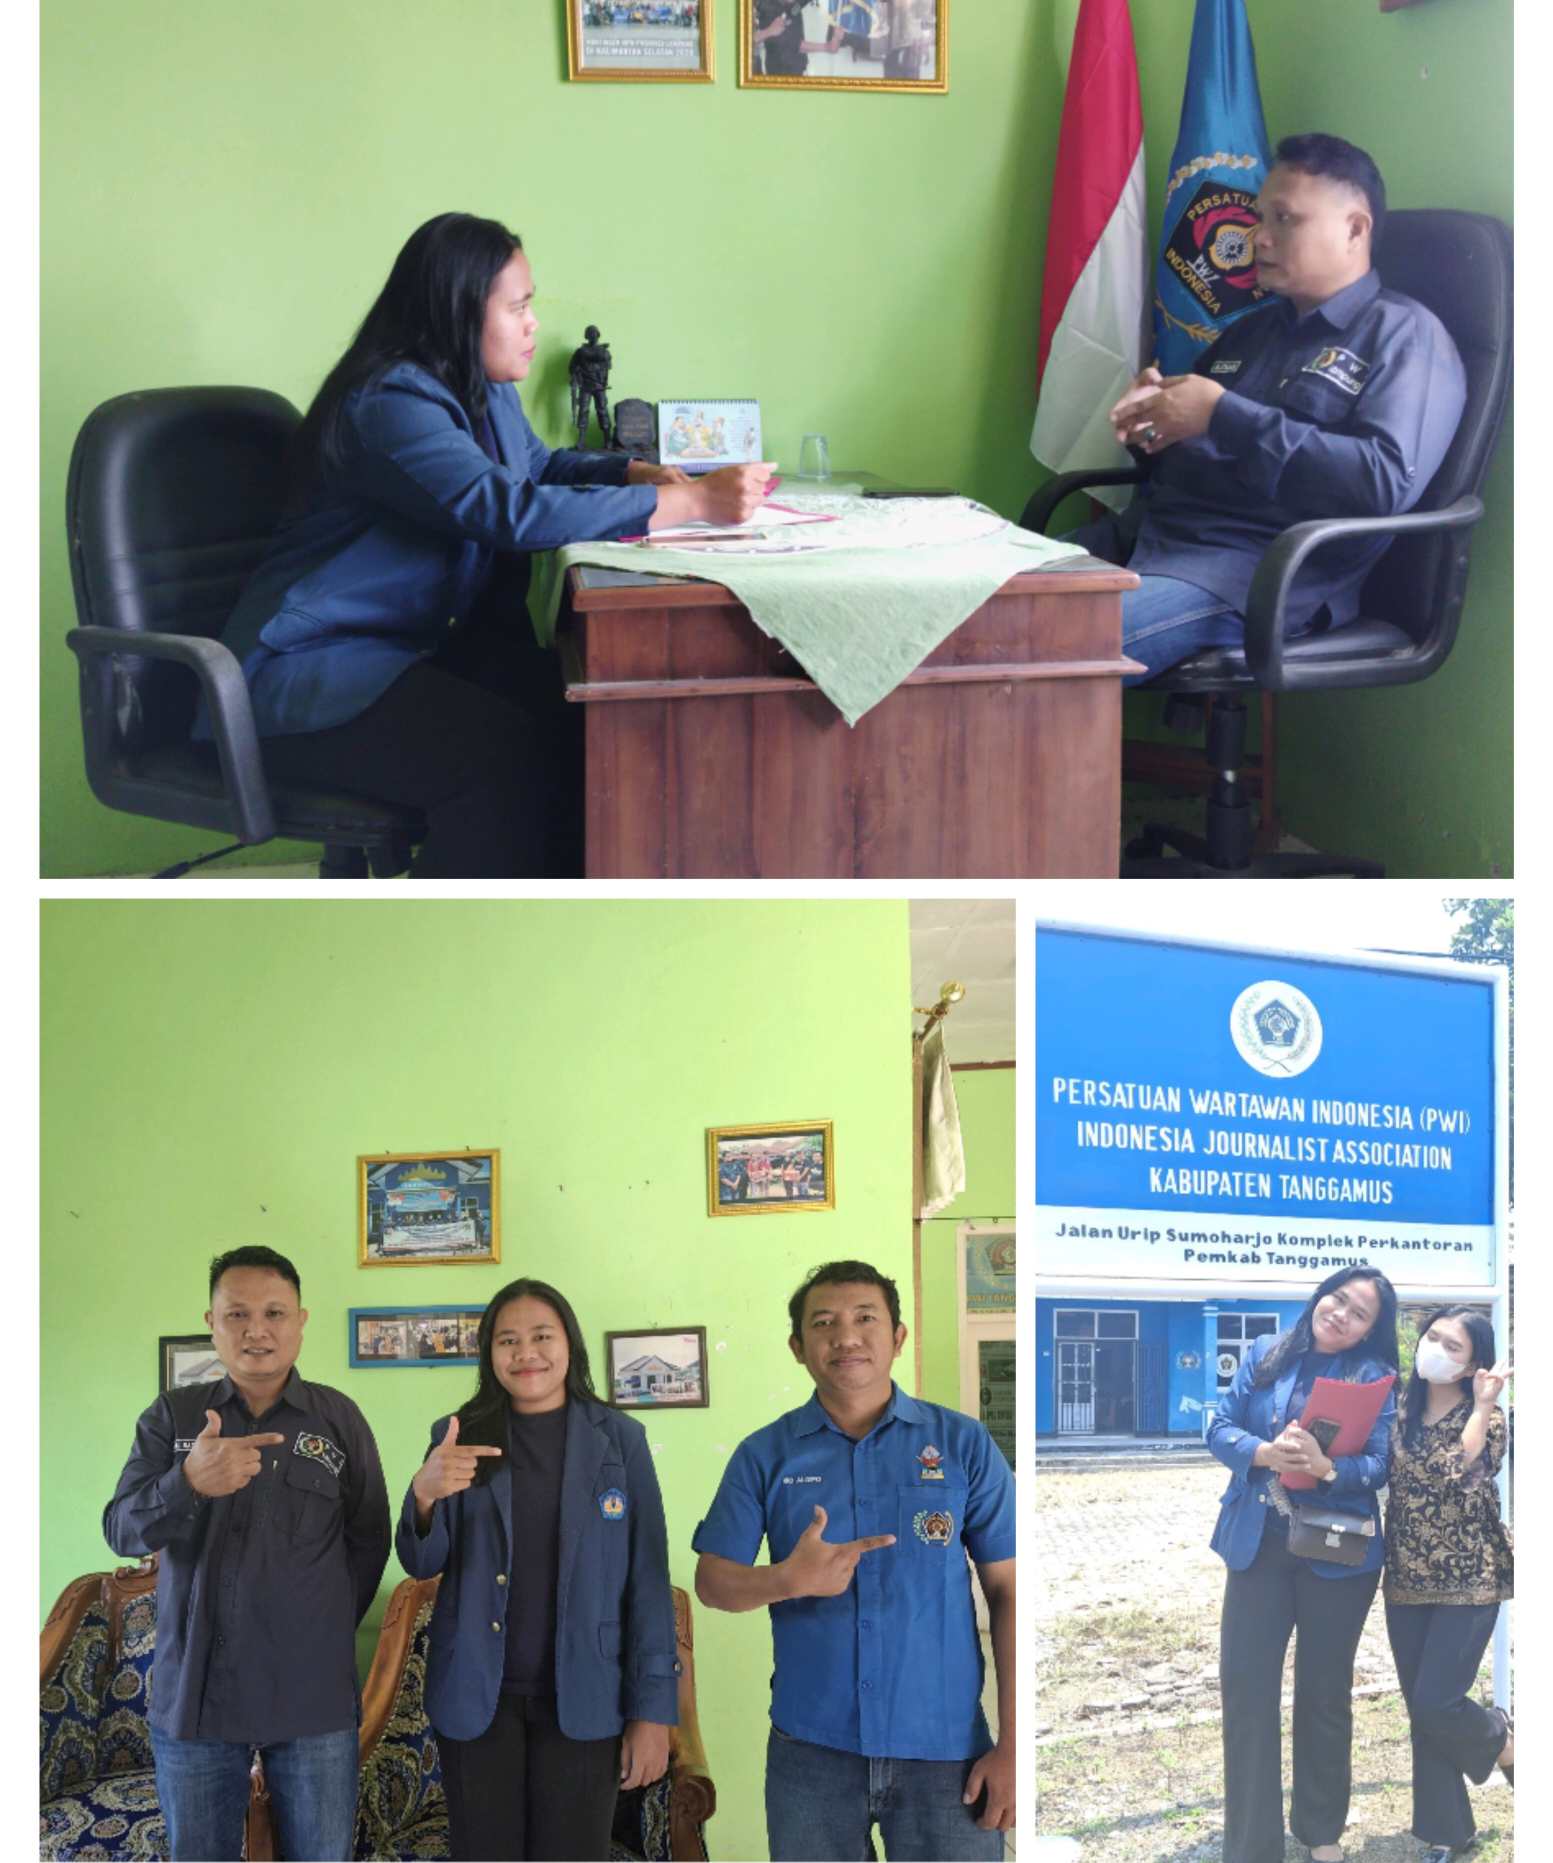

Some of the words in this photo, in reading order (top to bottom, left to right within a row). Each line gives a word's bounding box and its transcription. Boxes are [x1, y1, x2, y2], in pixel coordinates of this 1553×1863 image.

[1187, 193, 1258, 221] PERSATUA
[1166, 247, 1221, 314] INDONESIA
[1053, 1077, 1181, 1112] PERSATUAN
[1189, 1088, 1304, 1122] WARTAWAN
[1312, 1099, 1414, 1130] INDONESIA
[1419, 1106, 1471, 1136] (PWI)
[1077, 1120, 1195, 1153] INDONESIA
[1203, 1130, 1329, 1163] JOURNALIST
[1332, 1139, 1452, 1170] ASSOCIATION
[1150, 1167, 1271, 1198] KABUPATEN
[1279, 1174, 1393, 1205] TANGGAMUS
[1056, 1223, 1113, 1239] Jalan
[1118, 1226, 1160, 1244] Urip
[1166, 1228, 1272, 1248] Sumoharjo
[1277, 1233, 1354, 1249] Komplek
[1358, 1236, 1473, 1251] Perkantoran
[1184, 1249, 1261, 1264] Pemkab
[1266, 1252, 1368, 1269] Tanggamus
